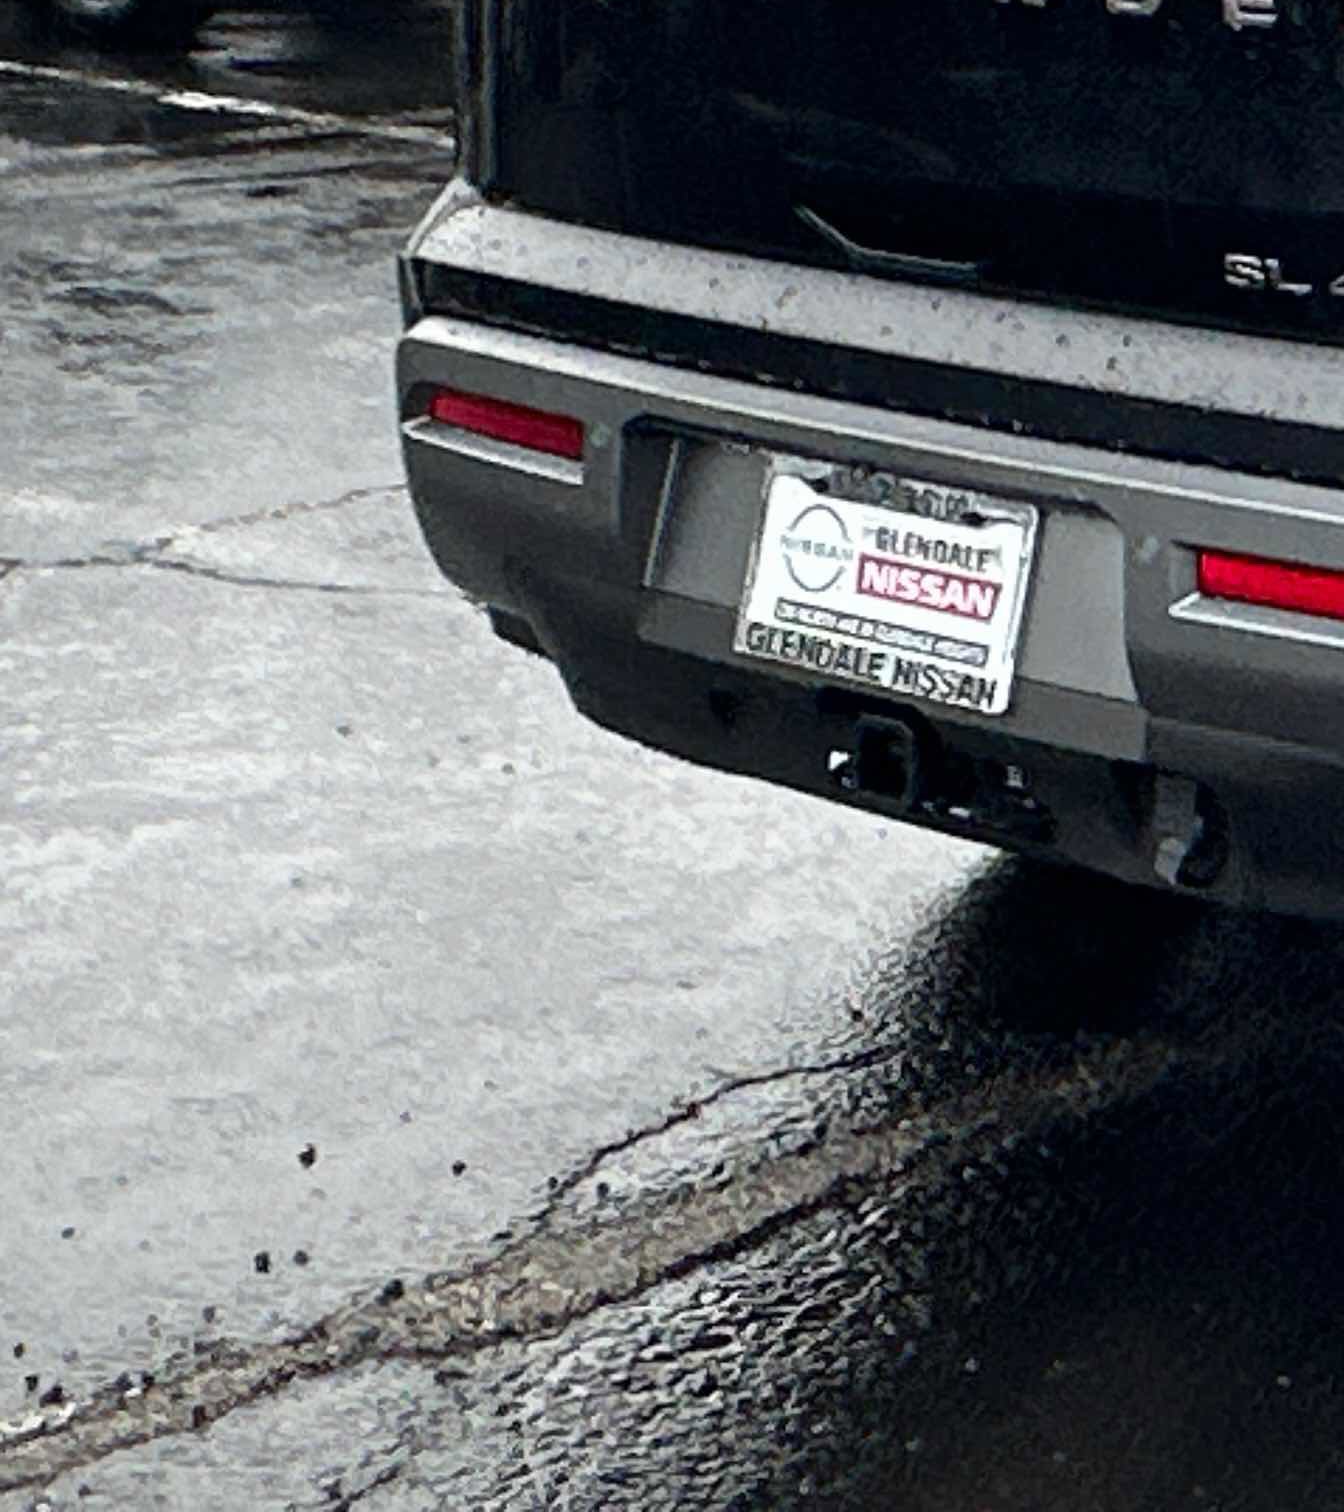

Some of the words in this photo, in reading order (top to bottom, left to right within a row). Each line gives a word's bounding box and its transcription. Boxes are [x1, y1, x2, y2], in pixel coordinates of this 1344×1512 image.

[1224, 253, 1313, 296] SL
[862, 561, 994, 616] NISSAN
[747, 622, 885, 683] GLENDALE
[892, 657, 997, 709] NISSAN
